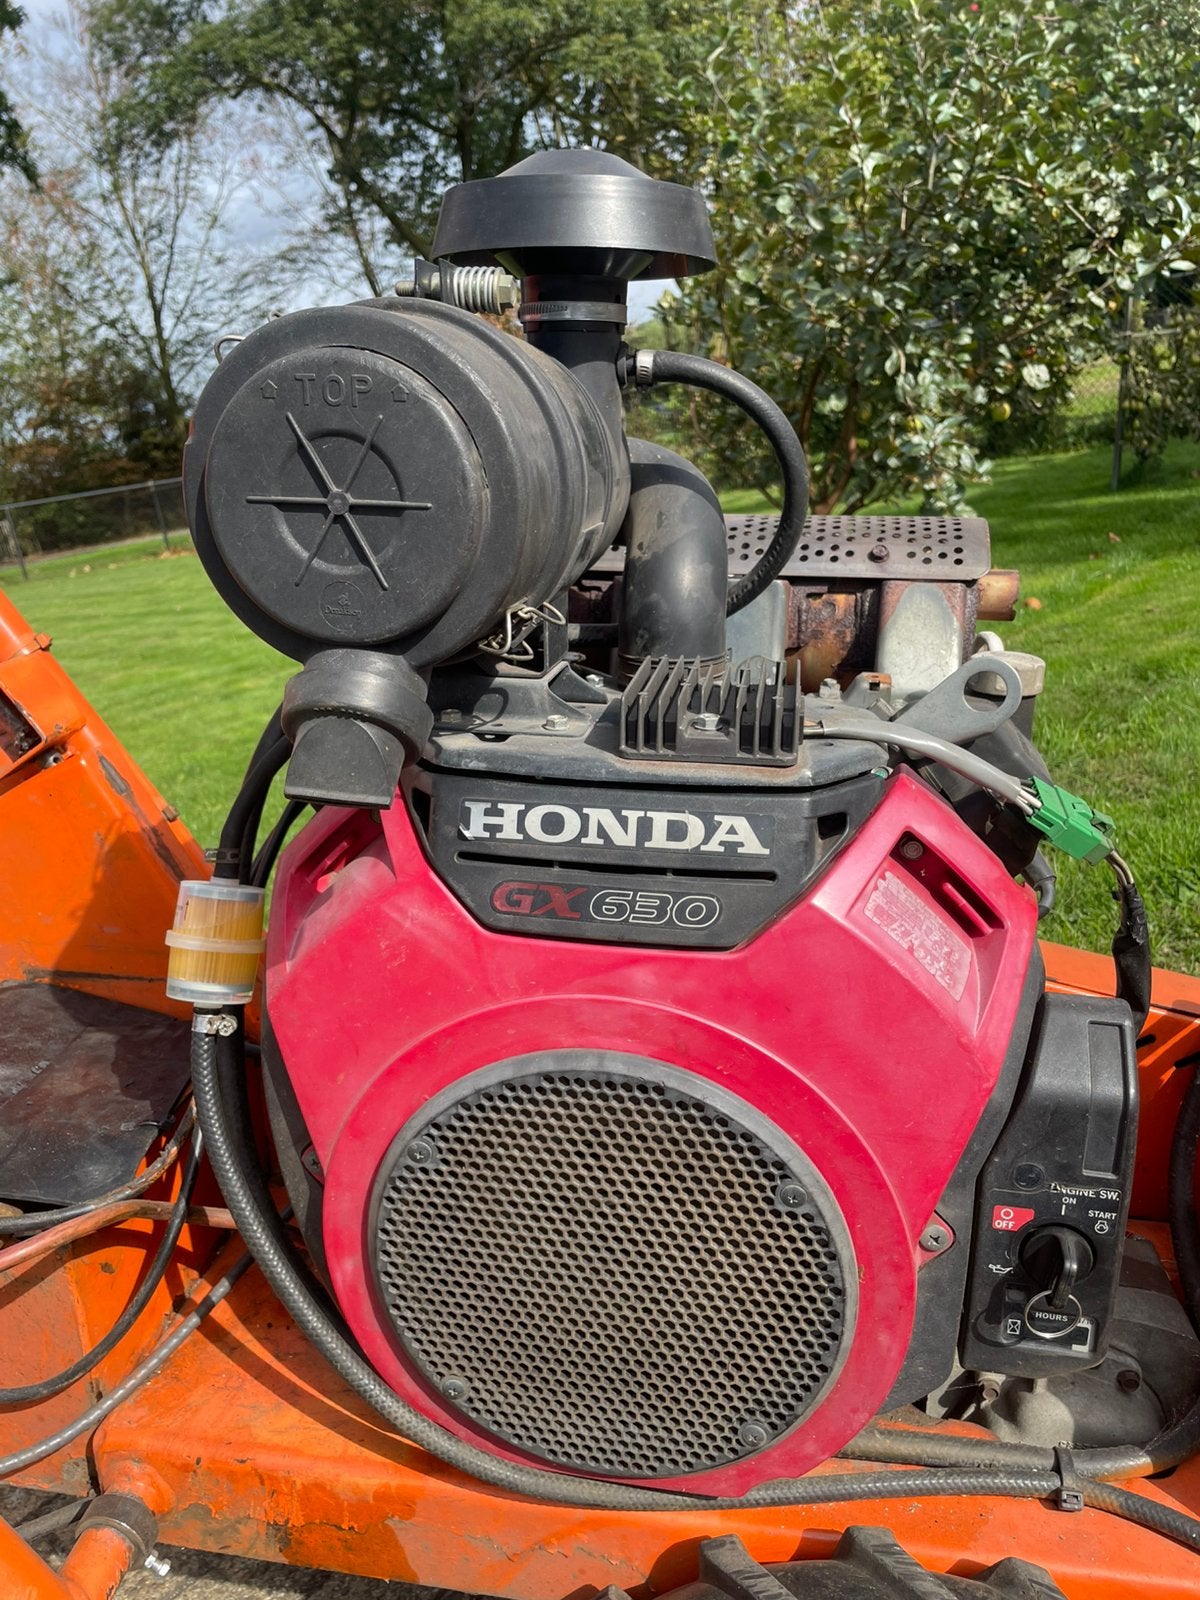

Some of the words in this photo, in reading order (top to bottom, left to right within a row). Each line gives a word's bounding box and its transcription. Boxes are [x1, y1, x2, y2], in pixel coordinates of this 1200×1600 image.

[294, 373, 373, 408] TOP
[464, 801, 770, 855] HONDA
[492, 882, 588, 919] GX
[590, 889, 719, 927] 630
[1062, 1196, 1077, 1205] ON
[1099, 1190, 1120, 1201] SW.
[1088, 1209, 1117, 1220] START
[995, 1220, 1015, 1229] OFF
[1035, 1311, 1068, 1322] HOURS
